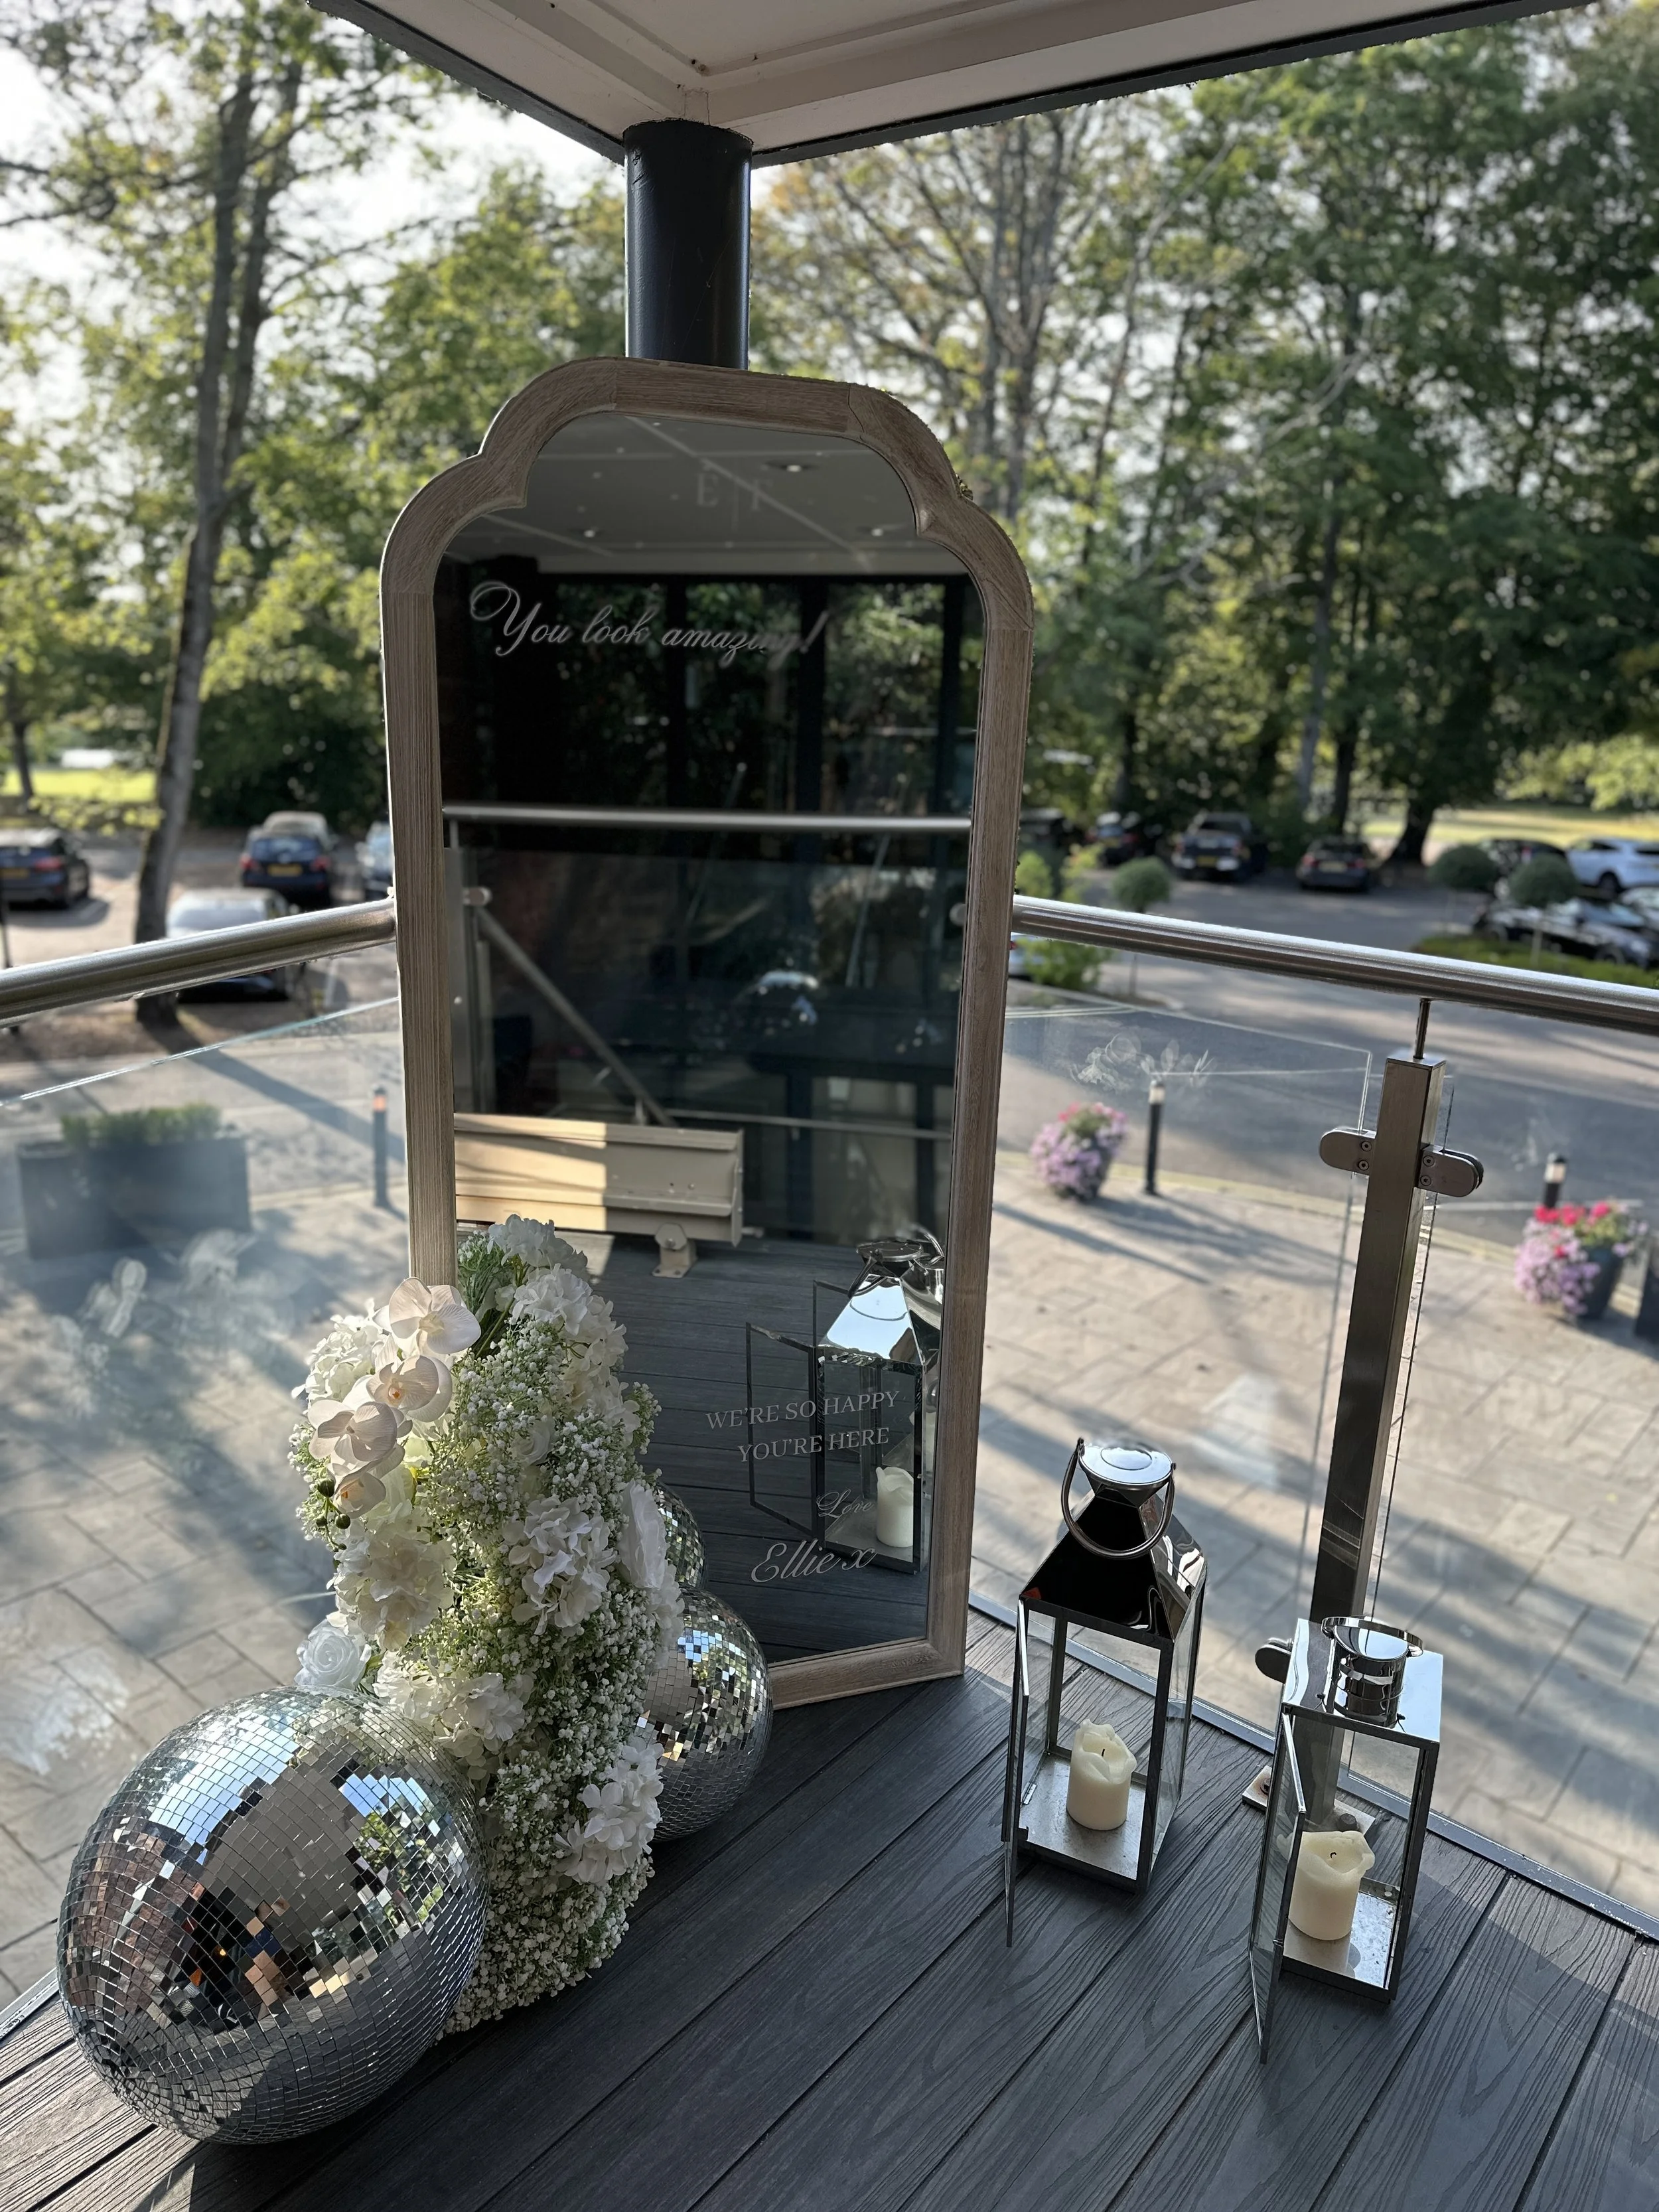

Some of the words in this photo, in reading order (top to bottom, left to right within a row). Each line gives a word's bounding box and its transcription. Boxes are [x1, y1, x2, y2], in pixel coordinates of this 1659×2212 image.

[469, 580, 571, 656] You
[582, 604, 659, 644] look
[661, 610, 830, 670] amazing!
[785, 1400, 817, 1420] SO
[822, 1390, 900, 1416] HAPPY
[828, 1427, 890, 1451] HERE
[816, 1488, 875, 1518] Love
[751, 1538, 843, 1583] Ellie
